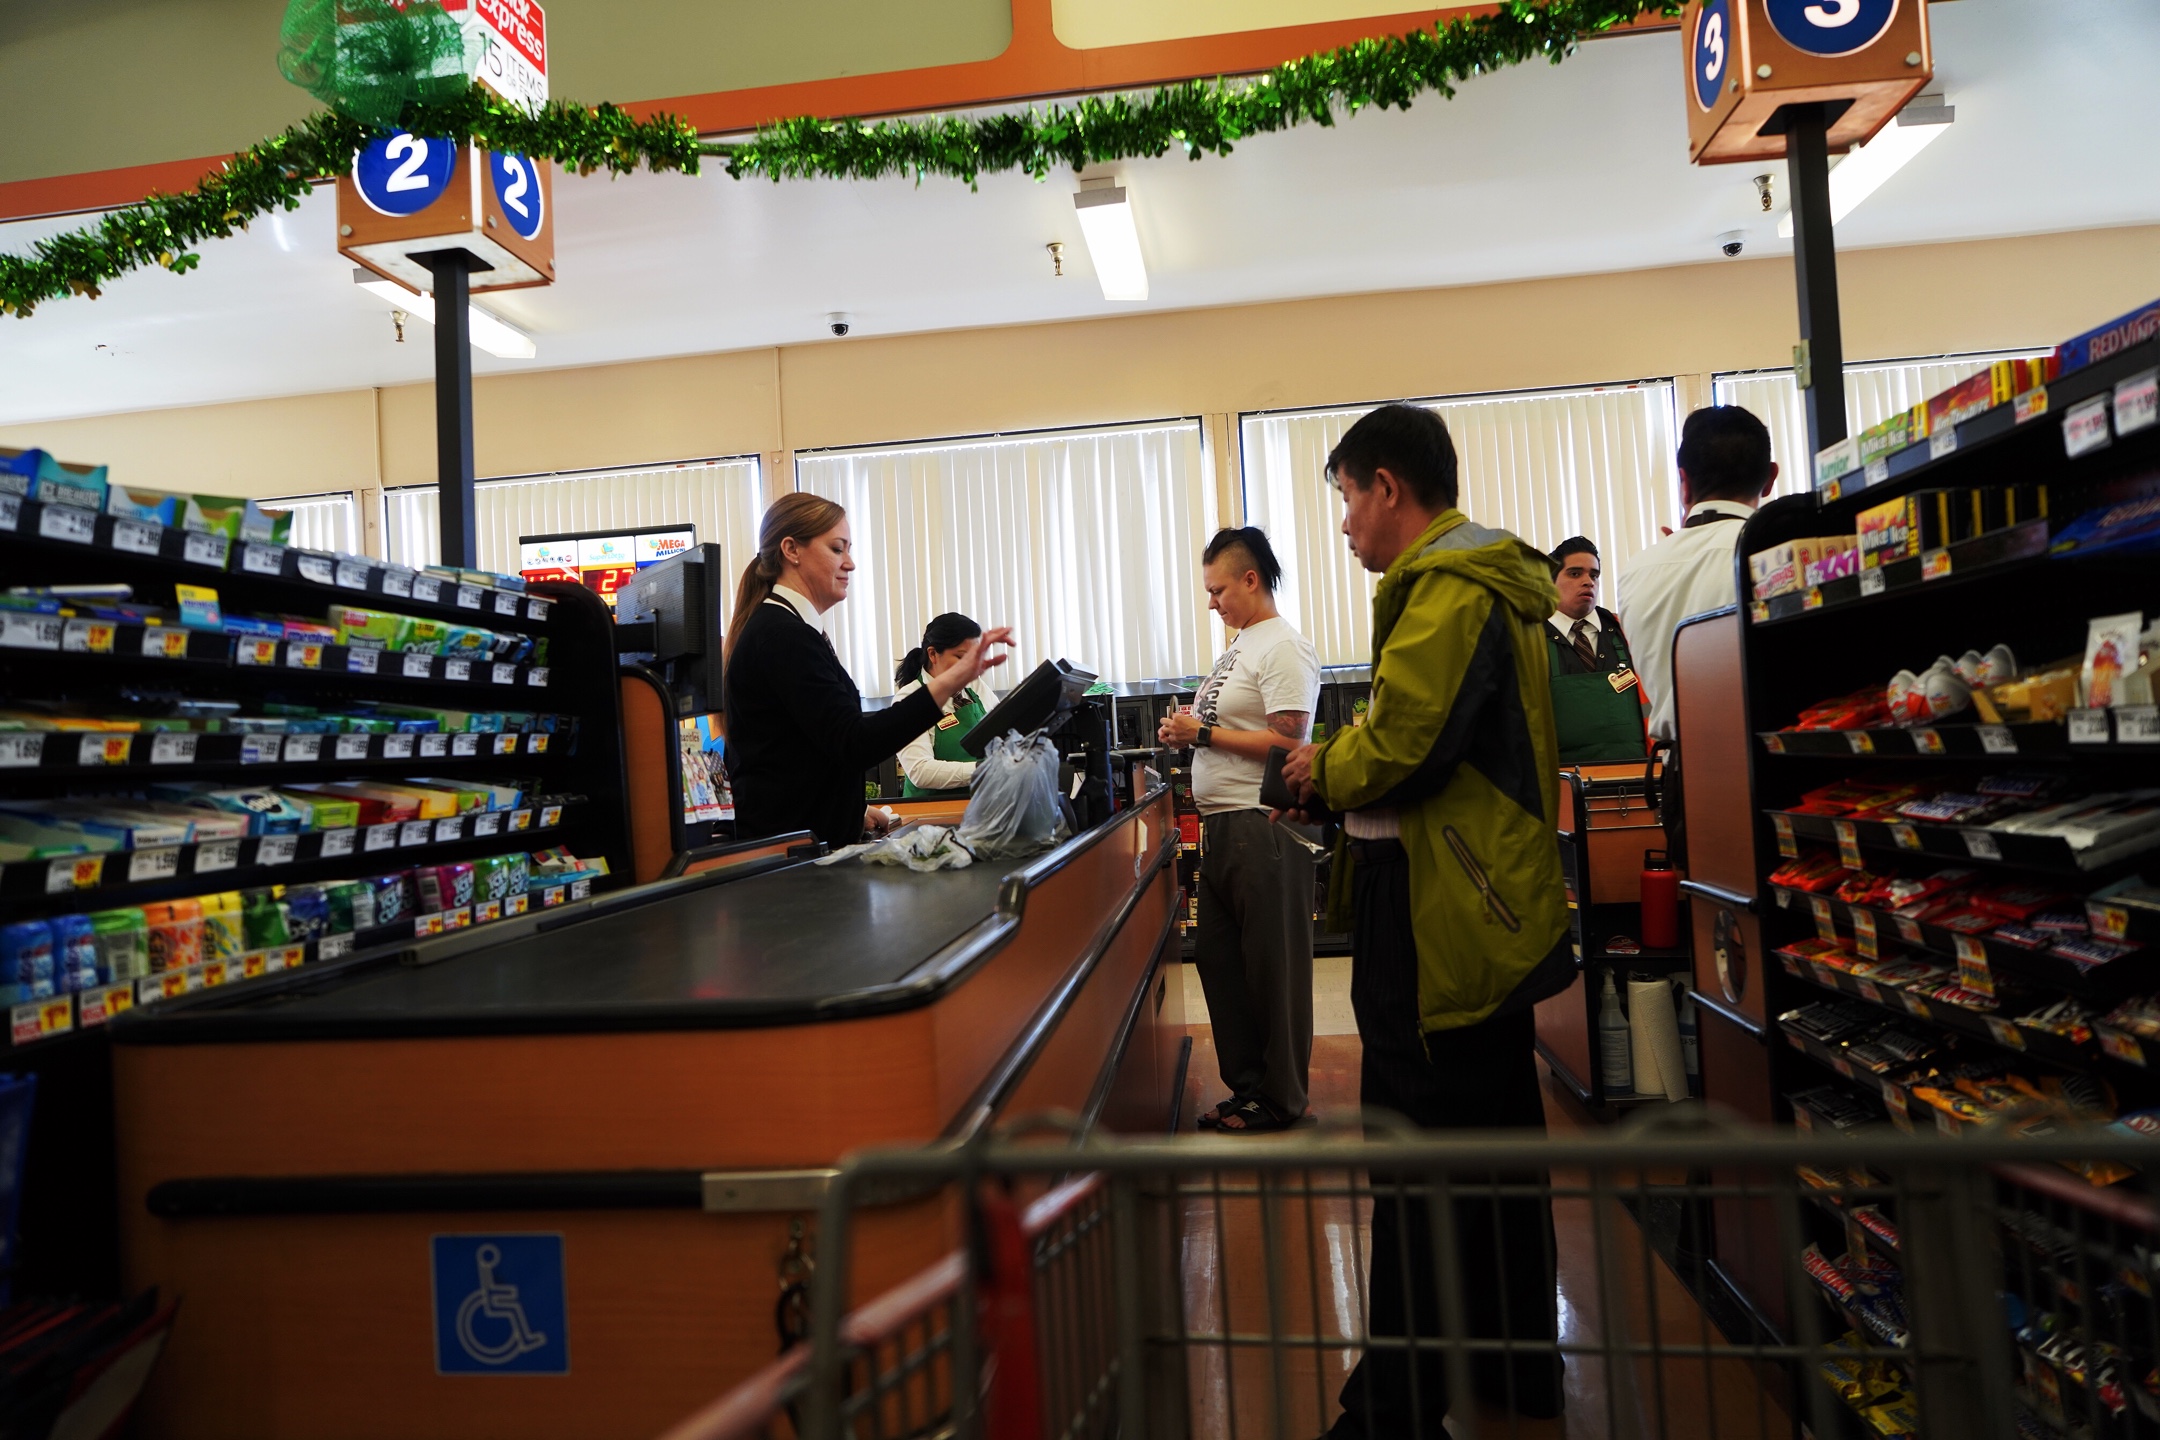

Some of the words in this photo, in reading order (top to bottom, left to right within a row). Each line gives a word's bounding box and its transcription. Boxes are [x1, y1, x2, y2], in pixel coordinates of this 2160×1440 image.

[478, 31, 502, 77] 15
[506, 51, 544, 101] ITEMS
[1704, 12, 1724, 81] 3
[386, 133, 429, 192] 2
[503, 155, 529, 218] 2
[657, 539, 685, 551] MEGA
